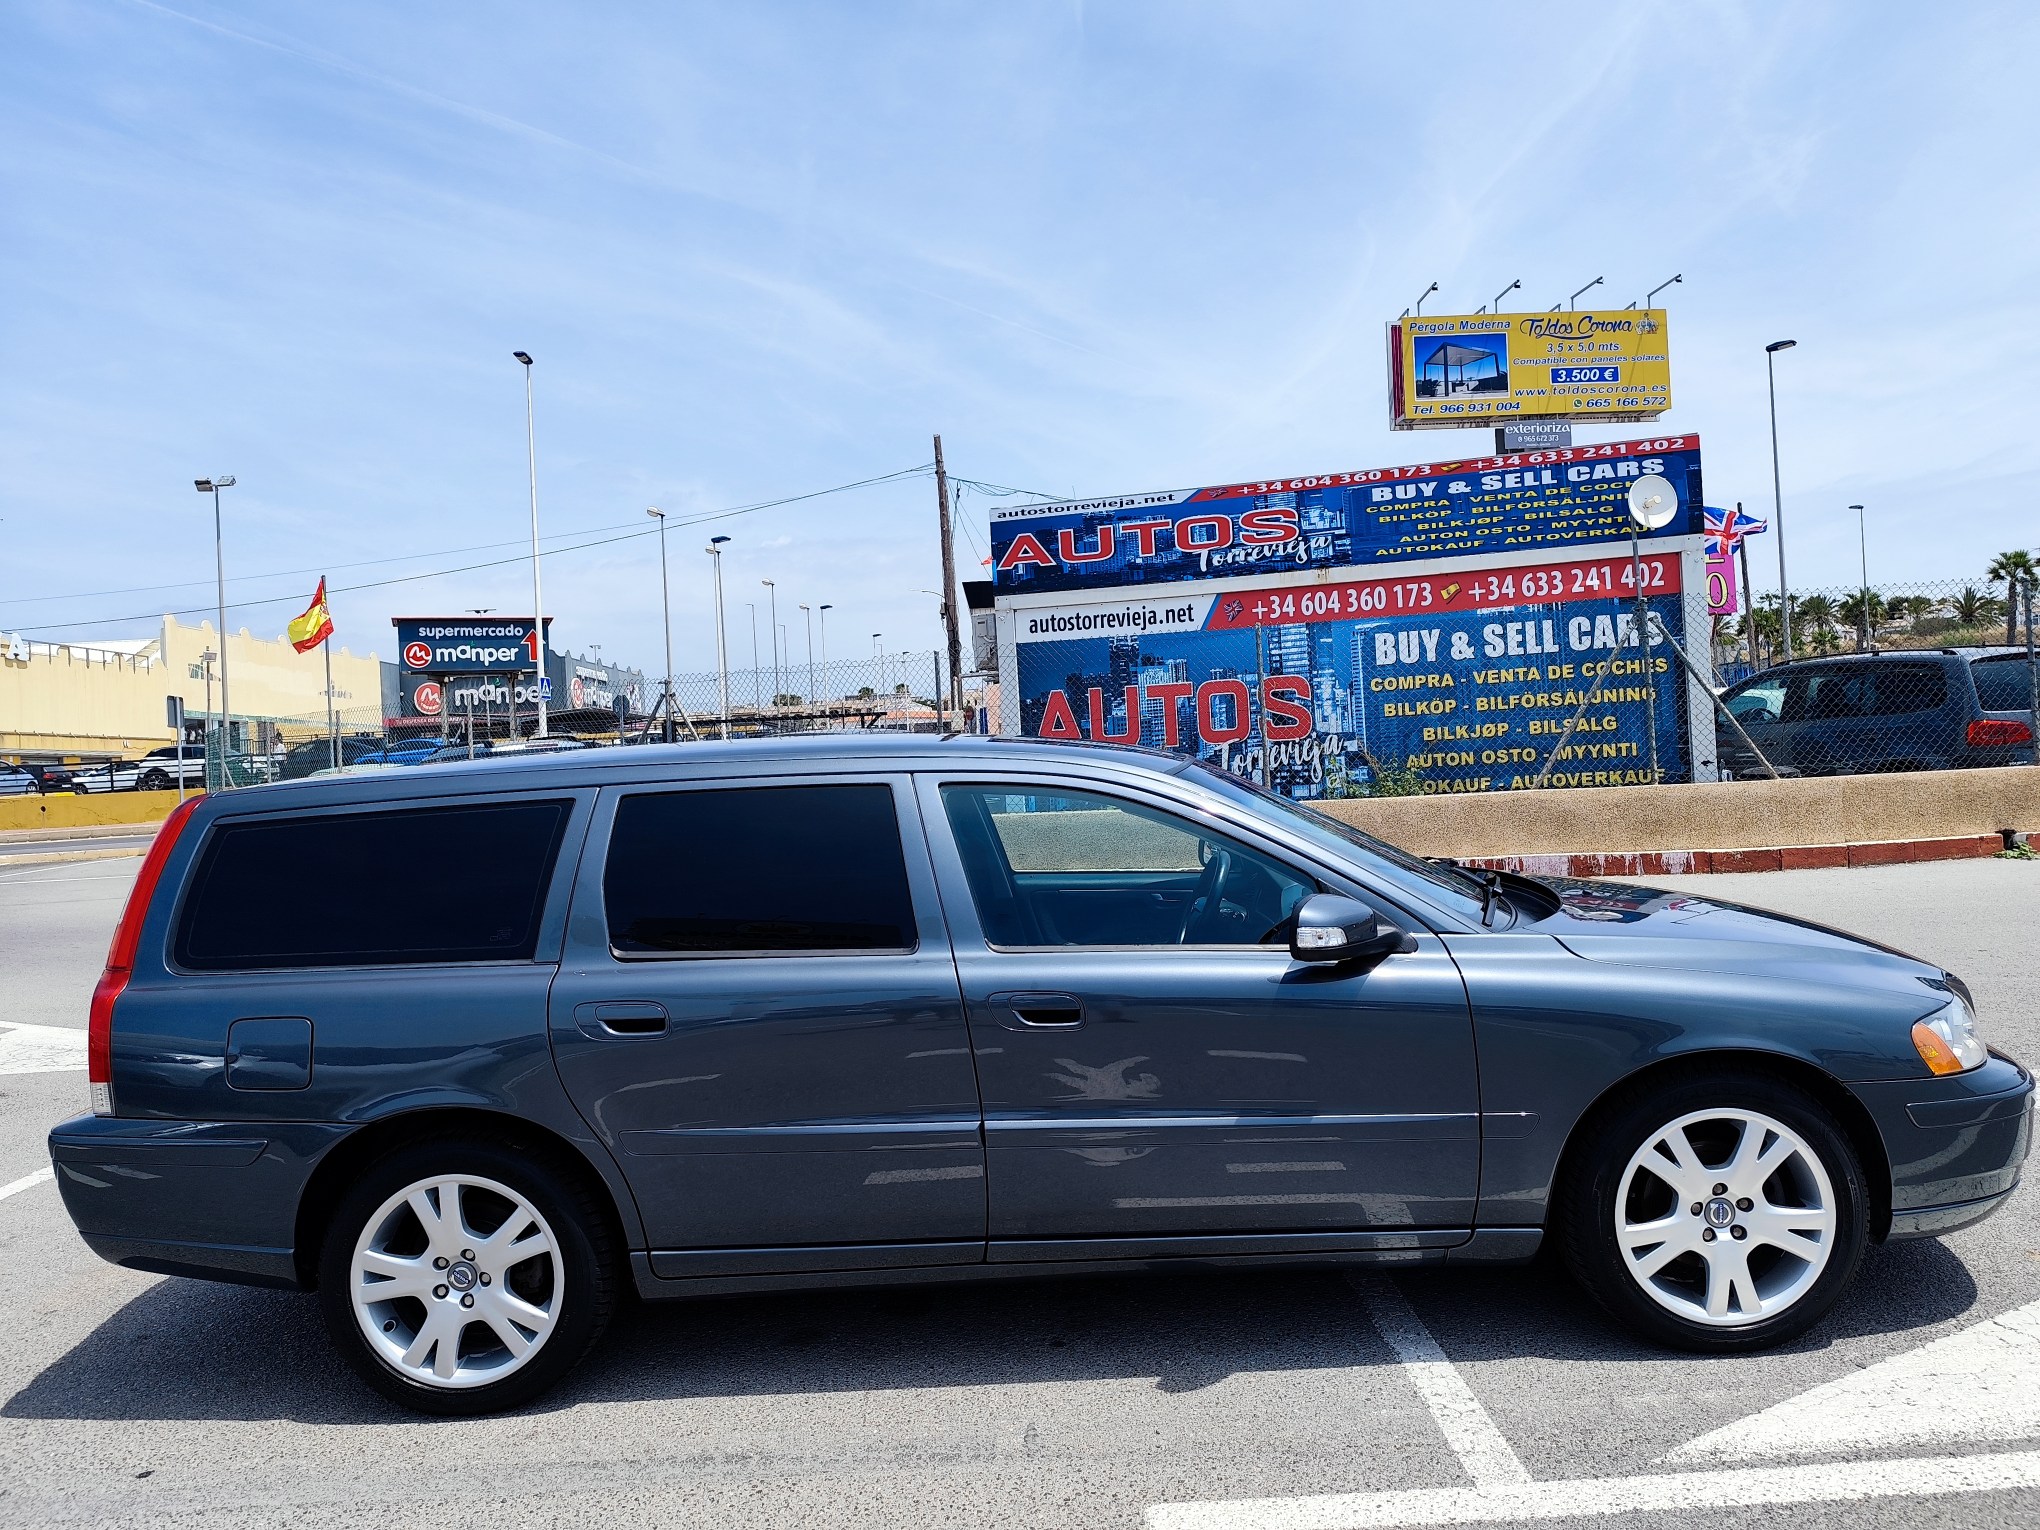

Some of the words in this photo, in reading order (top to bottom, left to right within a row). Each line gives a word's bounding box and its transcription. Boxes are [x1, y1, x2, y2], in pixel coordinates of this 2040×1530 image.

[1409, 321, 1455, 333] Pérgola
[1459, 319, 1511, 330] Moderna
[1519, 317, 1573, 340] Toldos
[1577, 315, 1633, 334] Corona
[1512, 355, 1566, 366] Compatible
[1570, 356, 1588, 364] con
[1591, 354, 1627, 366] paneles
[1630, 353, 1666, 362] solares
[1546, 341, 1563, 353] 3,5
[1567, 344, 1574, 352] x
[1578, 341, 1594, 353] 5,0
[1598, 341, 1623, 351] mts.
[1556, 368, 1599, 382] 3.500
[1603, 367, 1615, 381] €
[1514, 384, 1667, 397] www.toldoscorona.es
[1586, 398, 1613, 409] 665
[1615, 397, 1639, 408] 166
[1642, 395, 1667, 407] 572
[1412, 405, 1436, 415] Tel.
[1440, 403, 1464, 414] 966
[1467, 402, 1492, 413] 931
[1496, 401, 1521, 412] 004
[1505, 422, 1571, 434] exterioriza
[1523, 435, 1535, 443] 965
[1536, 434, 1548, 442] 672
[1237, 481, 1284, 495] +34
[1288, 478, 1334, 492] 604
[1340, 472, 1382, 484] 360
[1390, 466, 1432, 478] 173
[1471, 455, 1521, 471] +34
[1530, 449, 1575, 464] 633
[1584, 443, 1627, 458] 241
[1637, 437, 1685, 451] 402
[1372, 483, 1438, 502] BUY
[1448, 480, 1472, 494] &
[1482, 471, 1558, 490] SELL
[1568, 458, 1665, 481] CARS
[997, 493, 1175, 519] autostorrevieja.net
[1366, 499, 1450, 513] COMPRA
[1470, 490, 1537, 503] VENTA
[1545, 486, 1572, 495] DE
[1580, 480, 1634, 492] COCH
[1379, 510, 1452, 523] BILKÖP
[1472, 493, 1630, 515] BILFÖRSÄLJNI
[1417, 516, 1504, 530] BILKJØP
[1524, 505, 1614, 520] BILSALG
[997, 508, 1300, 571] AUTOS
[1375, 540, 1484, 556] AUTOKAUF
[1504, 525, 1655, 544] AUTOVERKAU
[1400, 530, 1469, 543] AUTON
[1476, 524, 1531, 536] OSTO
[1197, 534, 1331, 571] Torrevieja
[1252, 595, 1295, 619] +34
[1301, 593, 1341, 614] 604
[1347, 587, 1386, 612] 360
[1393, 583, 1432, 608] 173
[1468, 577, 1515, 602] +34
[1521, 571, 1564, 596] 633
[1572, 566, 1612, 592] 241
[1620, 561, 1664, 588] 402
[418, 624, 524, 639] supermercado
[1029, 604, 1194, 634] autostorrevieja.net
[435, 643, 519, 666] manper
[1375, 629, 1441, 665] BUY
[1450, 632, 1474, 660] &
[1483, 619, 1559, 658] SELL
[1371, 675, 1454, 692] COMPRA
[1474, 668, 1540, 685] VENTA
[1548, 664, 1575, 679] DE
[1038, 675, 1314, 748] AUTOS
[1384, 697, 1456, 717] BILKÖP
[1423, 722, 1509, 741] BILKJØP
[1407, 750, 1475, 769] AUTON
[1481, 747, 1536, 765] OSTO
[1557, 742, 1637, 761] MYYNTI
